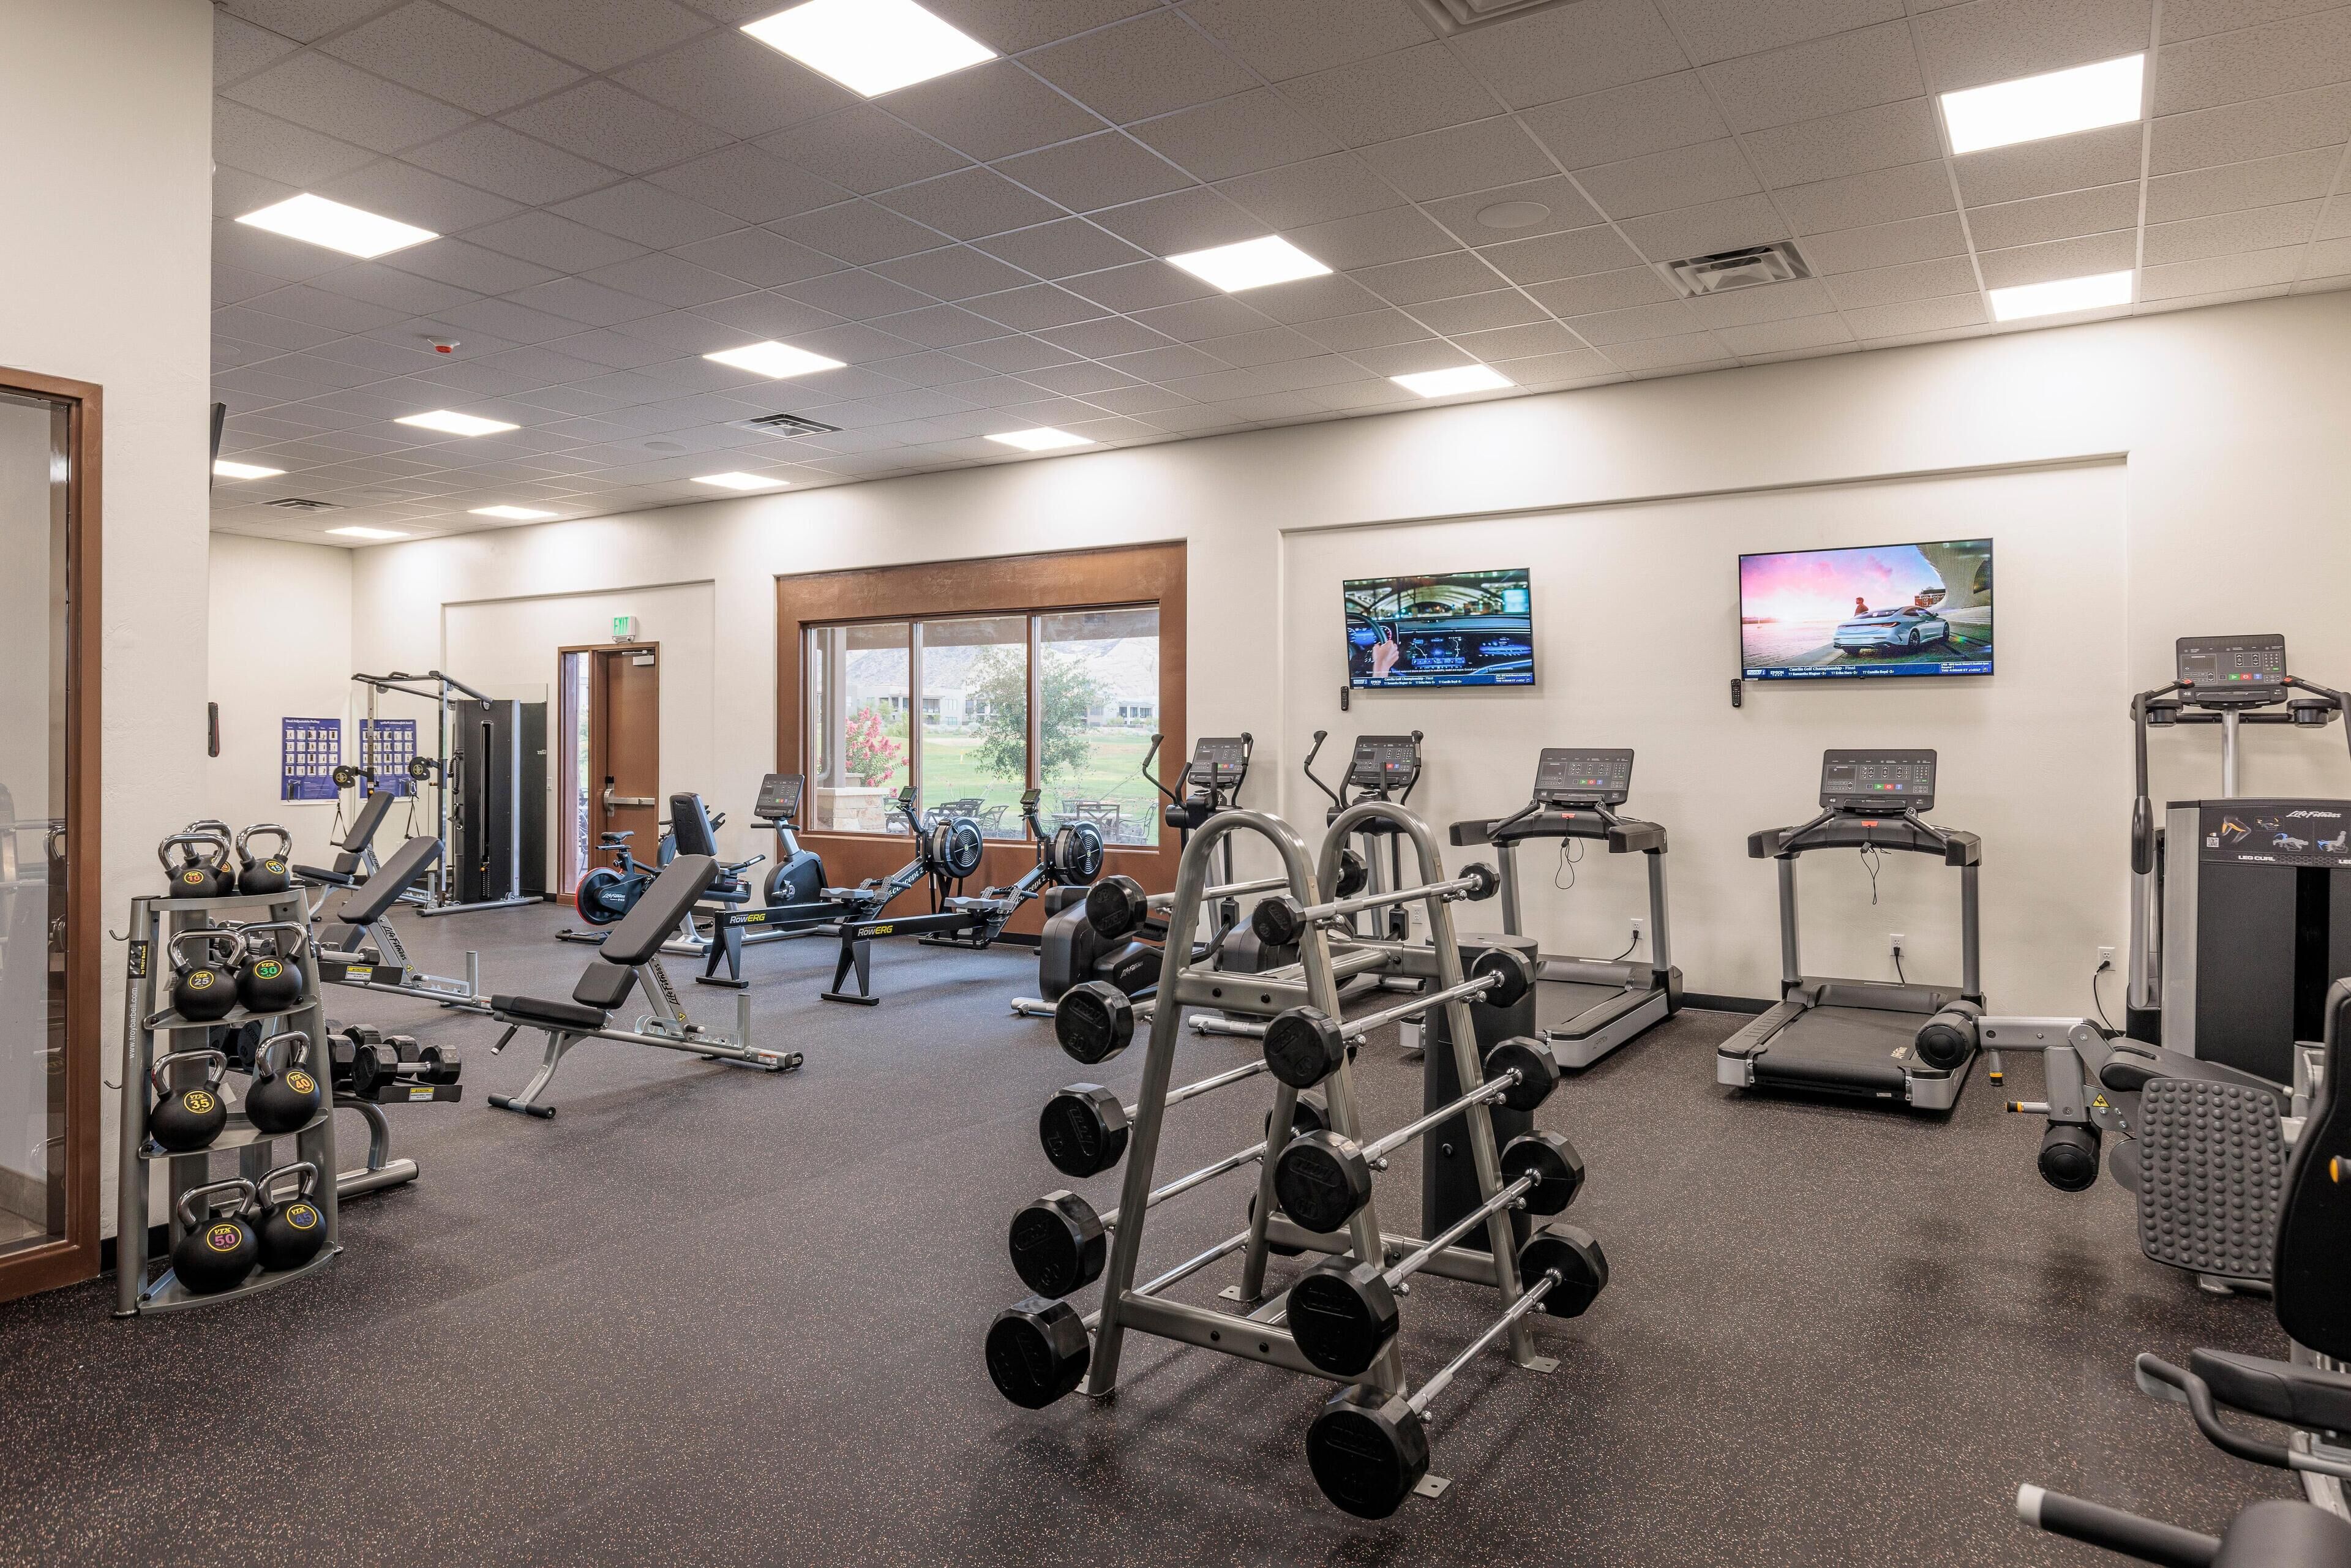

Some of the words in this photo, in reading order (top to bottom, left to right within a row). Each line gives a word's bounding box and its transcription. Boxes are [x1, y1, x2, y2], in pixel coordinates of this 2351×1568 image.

[614, 617, 629, 635] EXIT
[892, 871, 920, 894] cocept
[730, 913, 766, 924] RowERG
[858, 925, 893, 937] RowERG
[195, 977, 209, 986] 25
[296, 1079, 310, 1089] 40
[190, 1098, 209, 1109] 35
[295, 1212, 312, 1223] 45
[215, 1234, 236, 1245] 50
